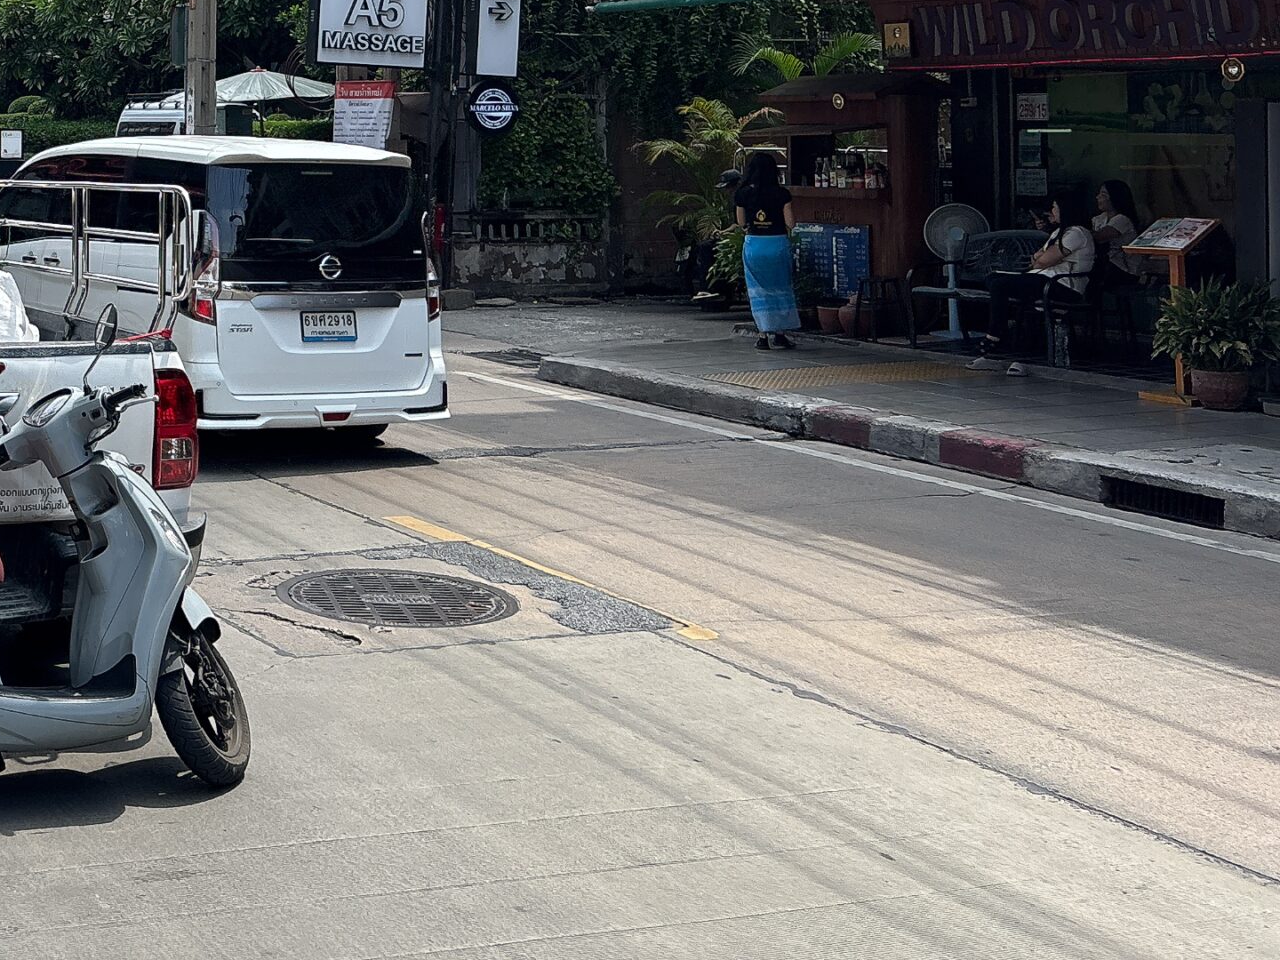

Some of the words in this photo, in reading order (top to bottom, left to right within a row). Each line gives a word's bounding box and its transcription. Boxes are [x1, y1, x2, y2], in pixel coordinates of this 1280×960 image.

[916, 0, 1036, 58] WILD
[322, 30, 424, 54] MASSAGE
[327, 314, 353, 327] 2918
